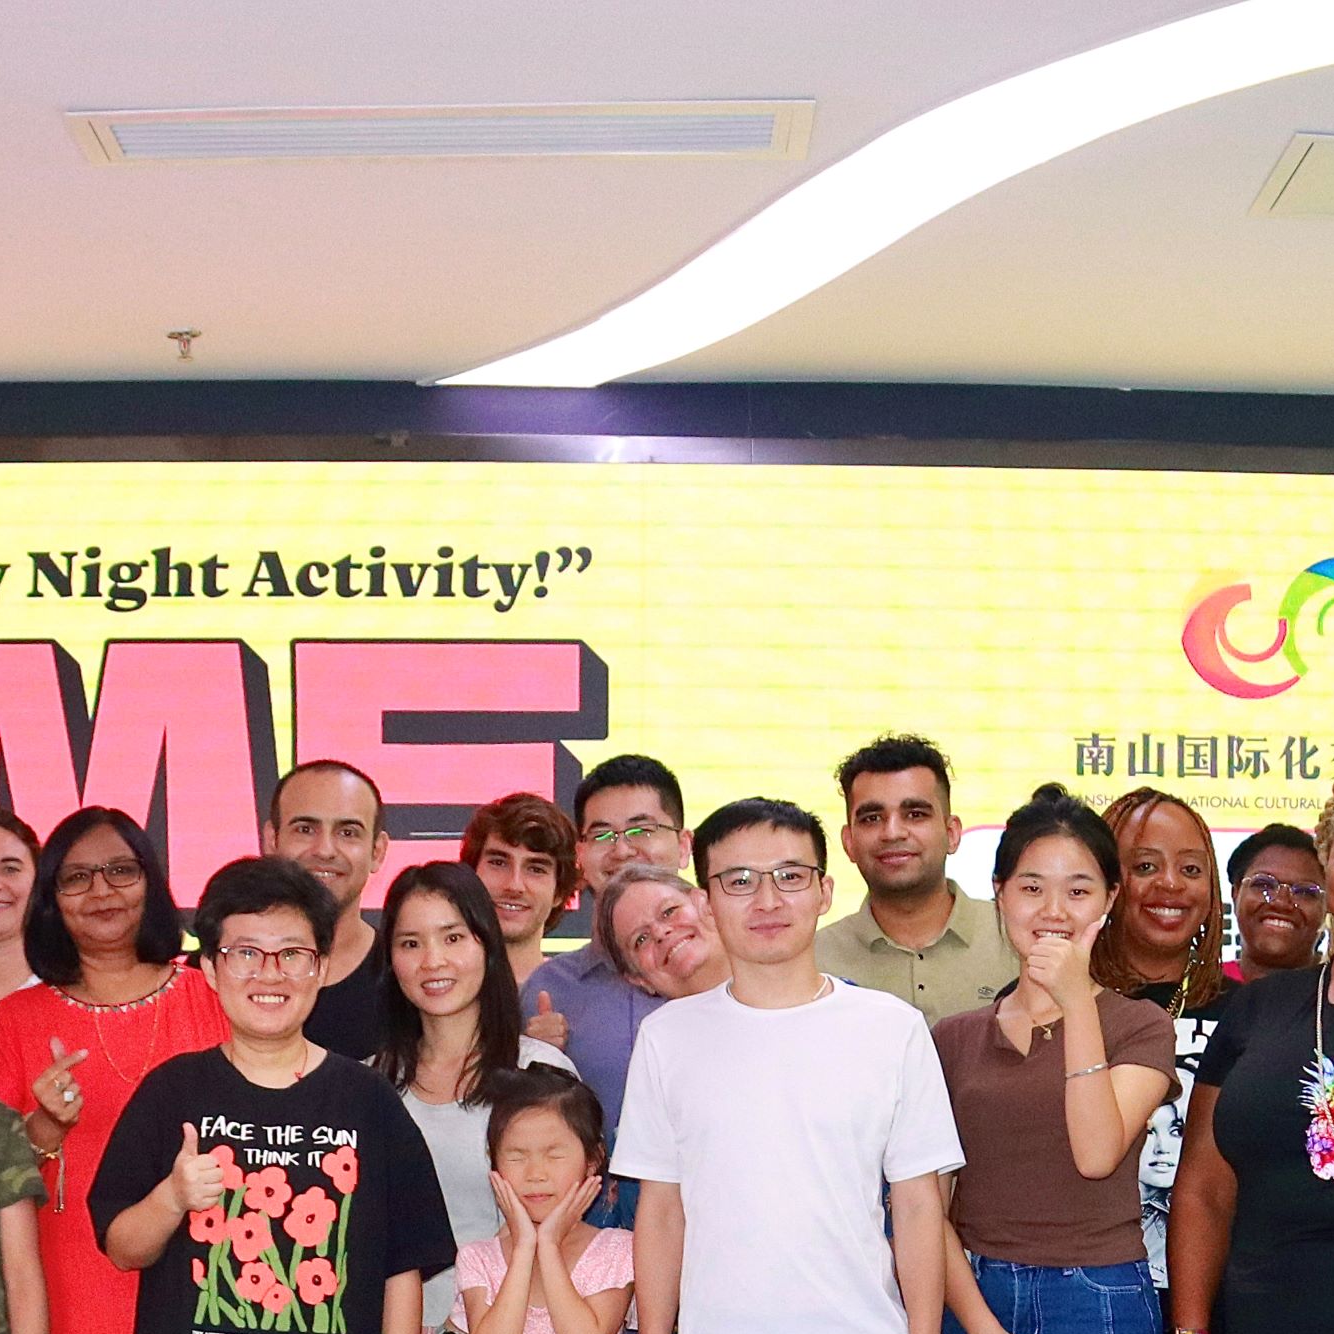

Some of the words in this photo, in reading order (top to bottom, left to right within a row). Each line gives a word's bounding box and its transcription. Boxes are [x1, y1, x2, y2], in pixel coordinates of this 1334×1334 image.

[27, 546, 230, 613] Night
[241, 546, 593, 613] Activity!”
[1254, 796, 1323, 809] CULTURAL
[200, 1115, 255, 1141] FACE
[262, 1125, 304, 1146] THE
[311, 1126, 357, 1149] SUN
[243, 1148, 299, 1166] THINK
[307, 1151, 325, 1168] IT
